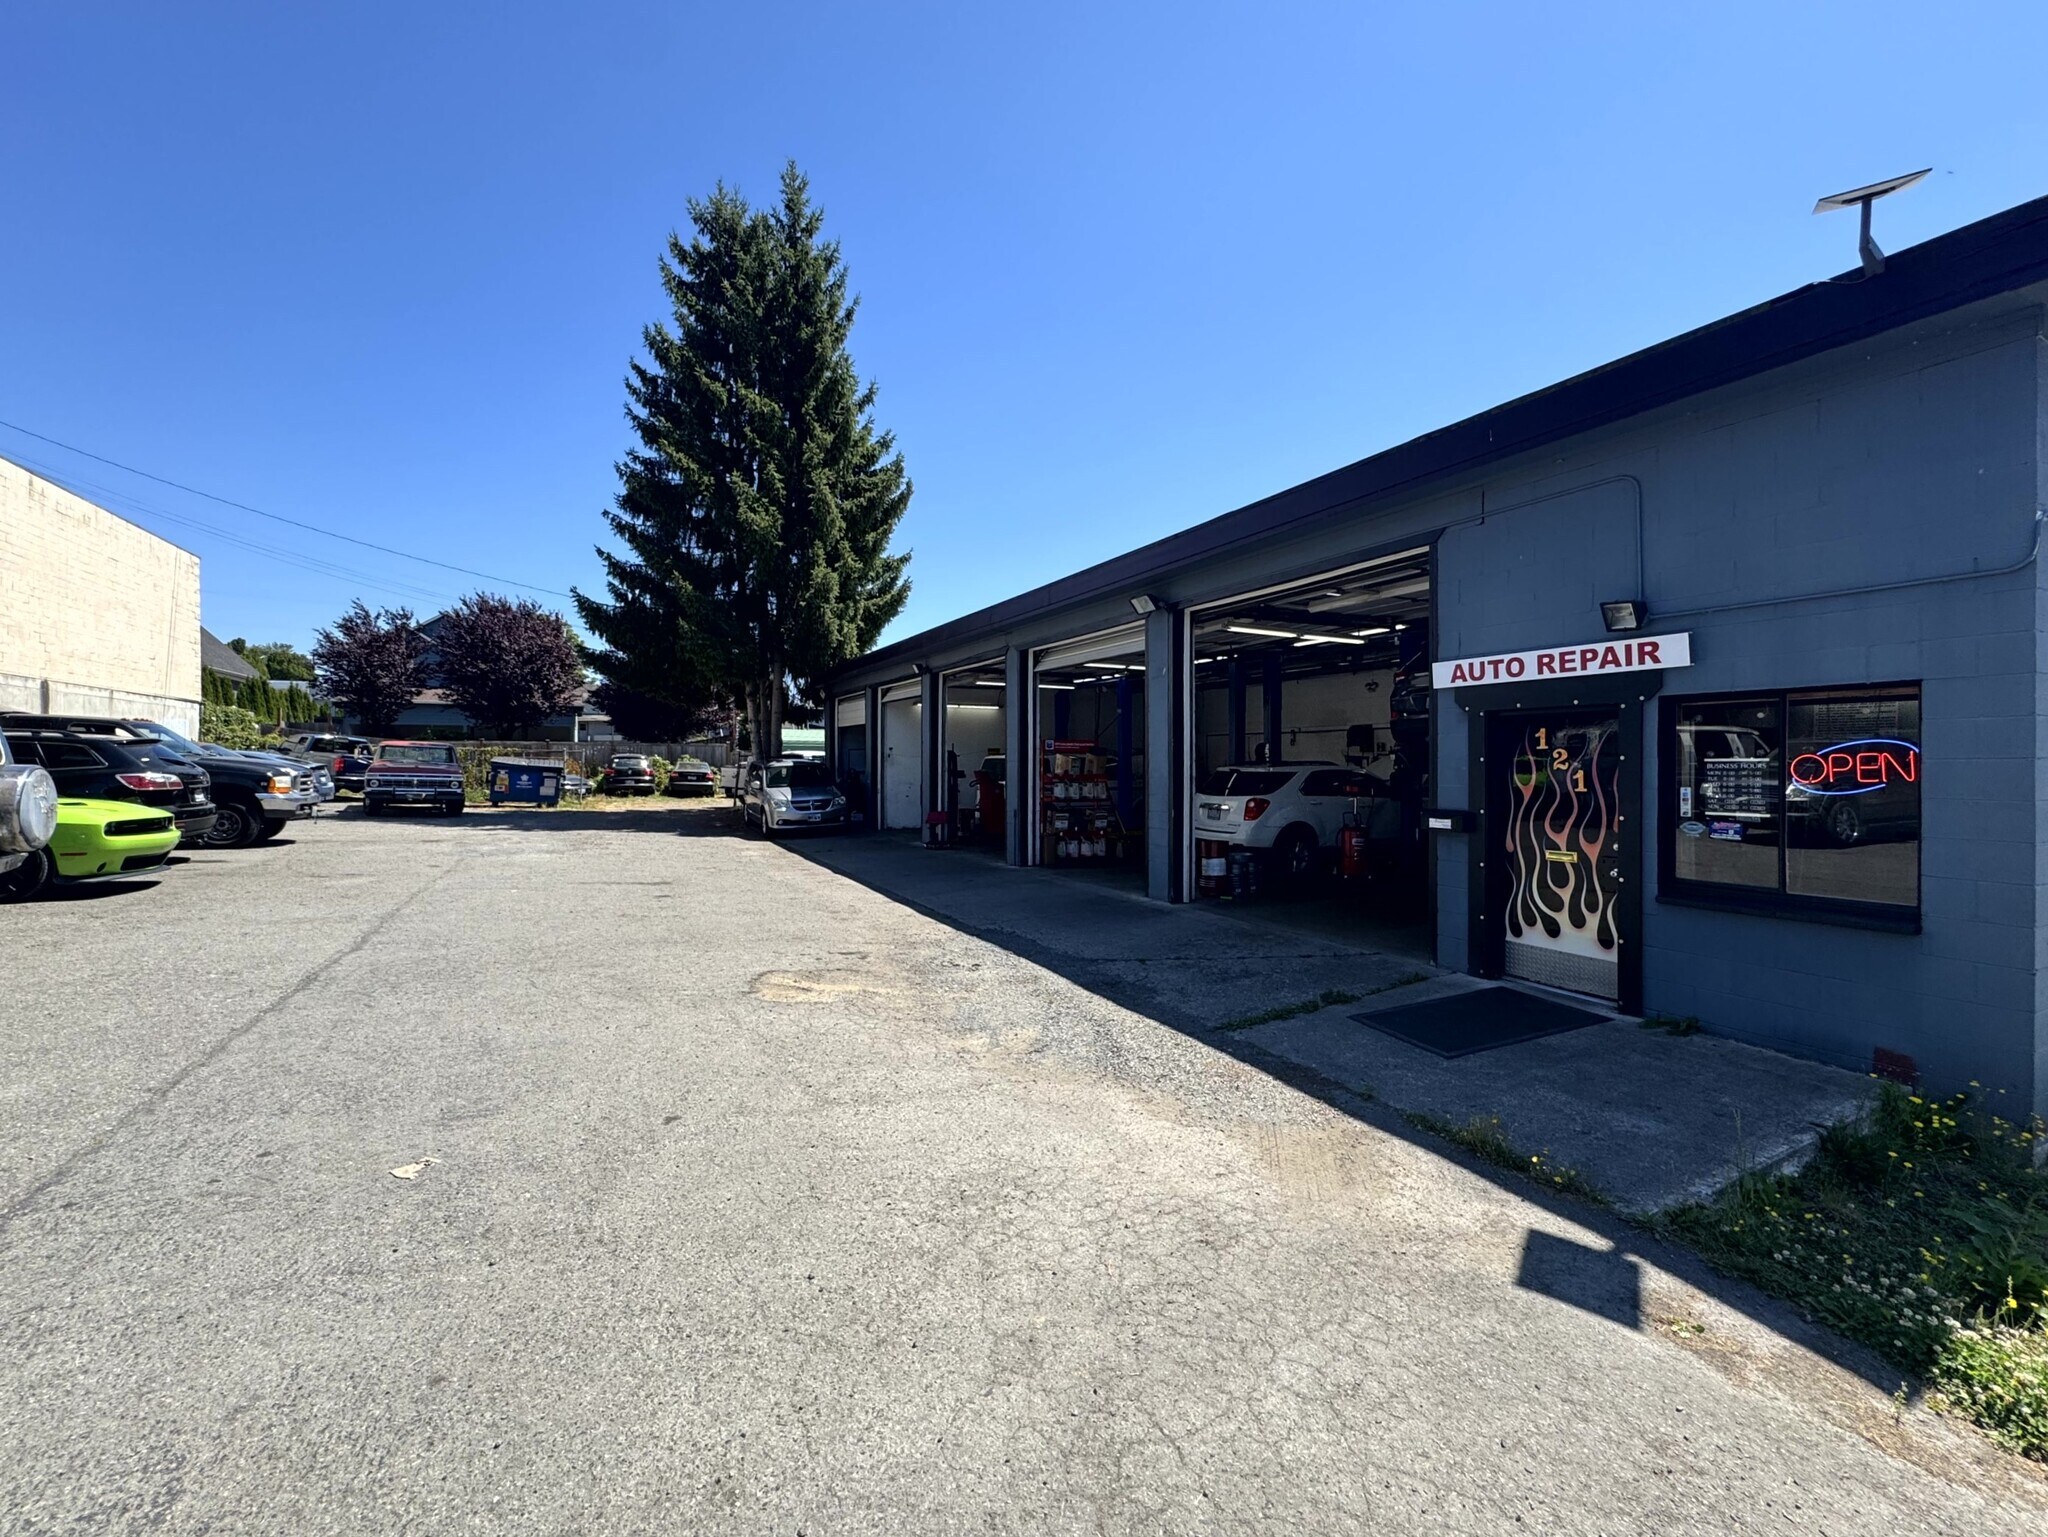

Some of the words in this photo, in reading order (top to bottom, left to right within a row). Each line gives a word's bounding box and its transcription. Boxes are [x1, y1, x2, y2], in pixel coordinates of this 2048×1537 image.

[1450, 656, 1525, 684] AUTO
[1536, 641, 1662, 676] REPAIR
[1790, 750, 1915, 784] OPEN
